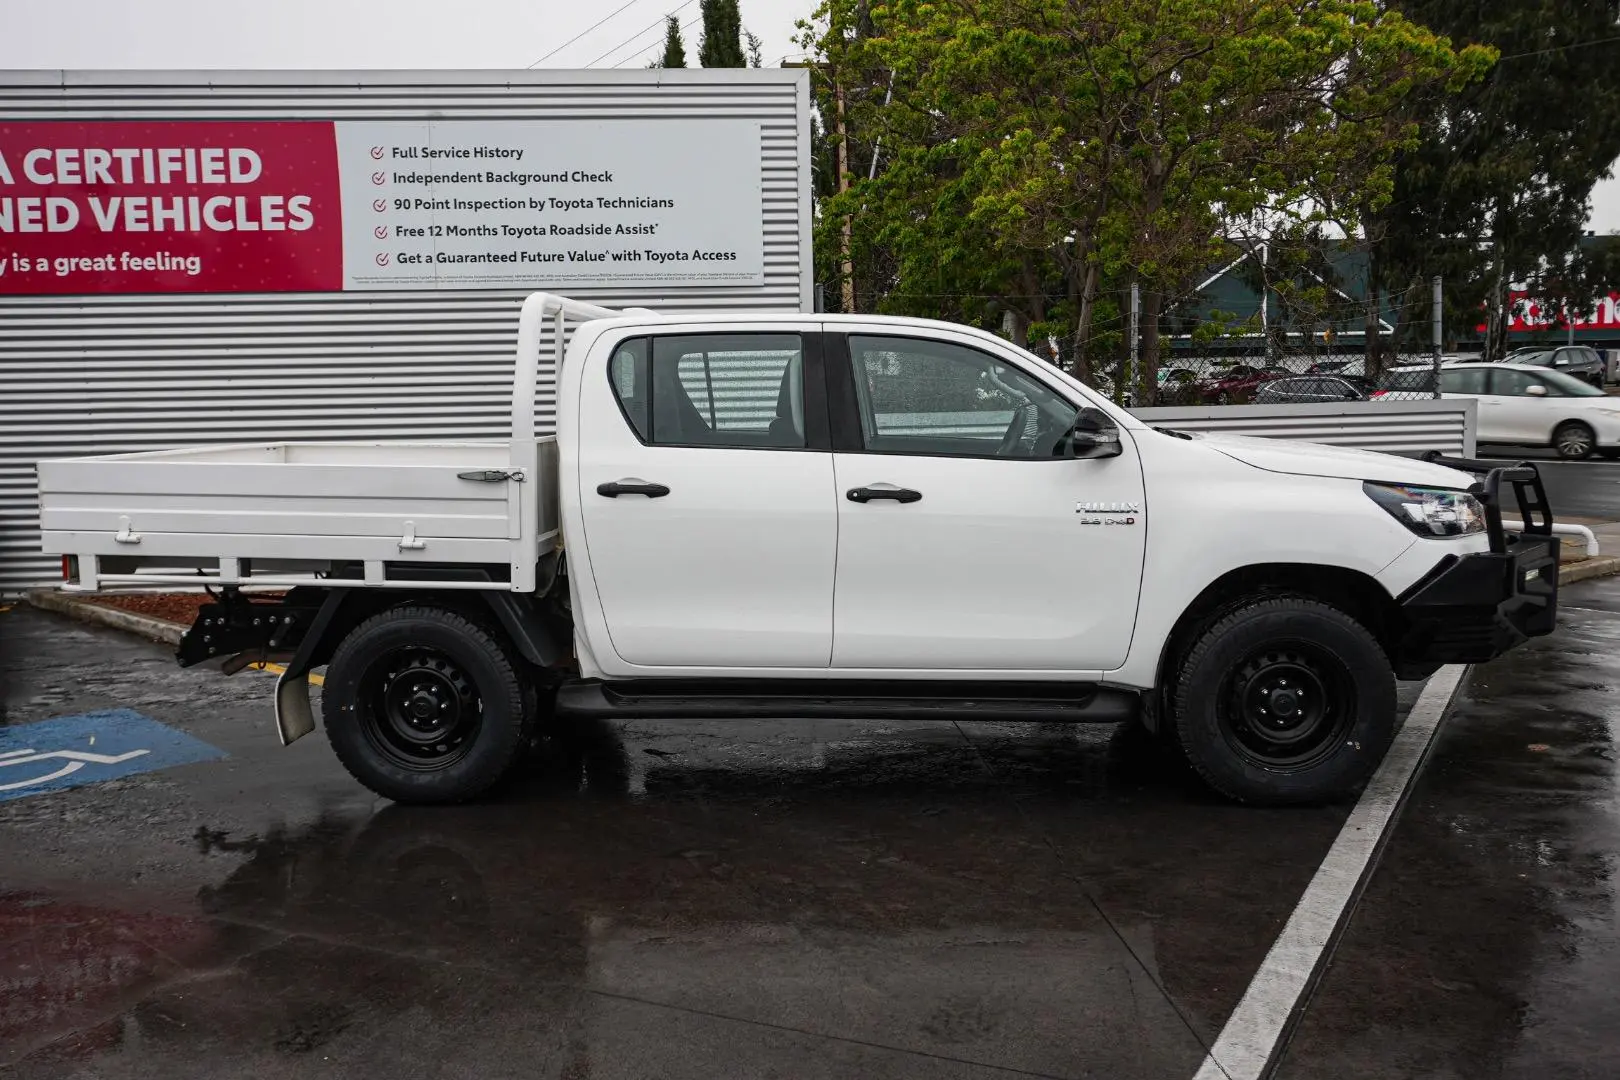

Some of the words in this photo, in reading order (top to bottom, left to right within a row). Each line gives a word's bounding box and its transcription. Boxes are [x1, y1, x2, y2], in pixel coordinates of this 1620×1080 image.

[392, 146, 418, 159] Full
[421, 146, 471, 159] Service
[473, 146, 524, 161] History
[23, 148, 262, 185] CERTIFIED
[393, 171, 483, 187] Independent
[486, 170, 568, 186] Background
[571, 170, 613, 183] Check
[394, 198, 411, 210] 90
[414, 197, 451, 210] Point
[453, 197, 526, 213] Inspection
[529, 197, 546, 212] by
[548, 197, 594, 212] Toyota
[596, 196, 674, 209] Technicians
[87, 195, 314, 232] VEHICLES
[395, 225, 425, 237] Free
[427, 225, 443, 237] 12
[446, 224, 498, 237] Months
[500, 224, 546, 239] Toyota
[549, 223, 612, 236] Roadside
[12, 252, 31, 272] is
[35, 257, 49, 272] a
[54, 253, 117, 277] great
[119, 251, 201, 277] feeling
[396, 252, 422, 264] Get
[425, 255, 433, 264] a
[436, 250, 517, 264] Guaranteed
[520, 251, 565, 263] Future
[611, 249, 642, 262] with
[644, 249, 689, 264] Toyota
[691, 249, 737, 261] Access
